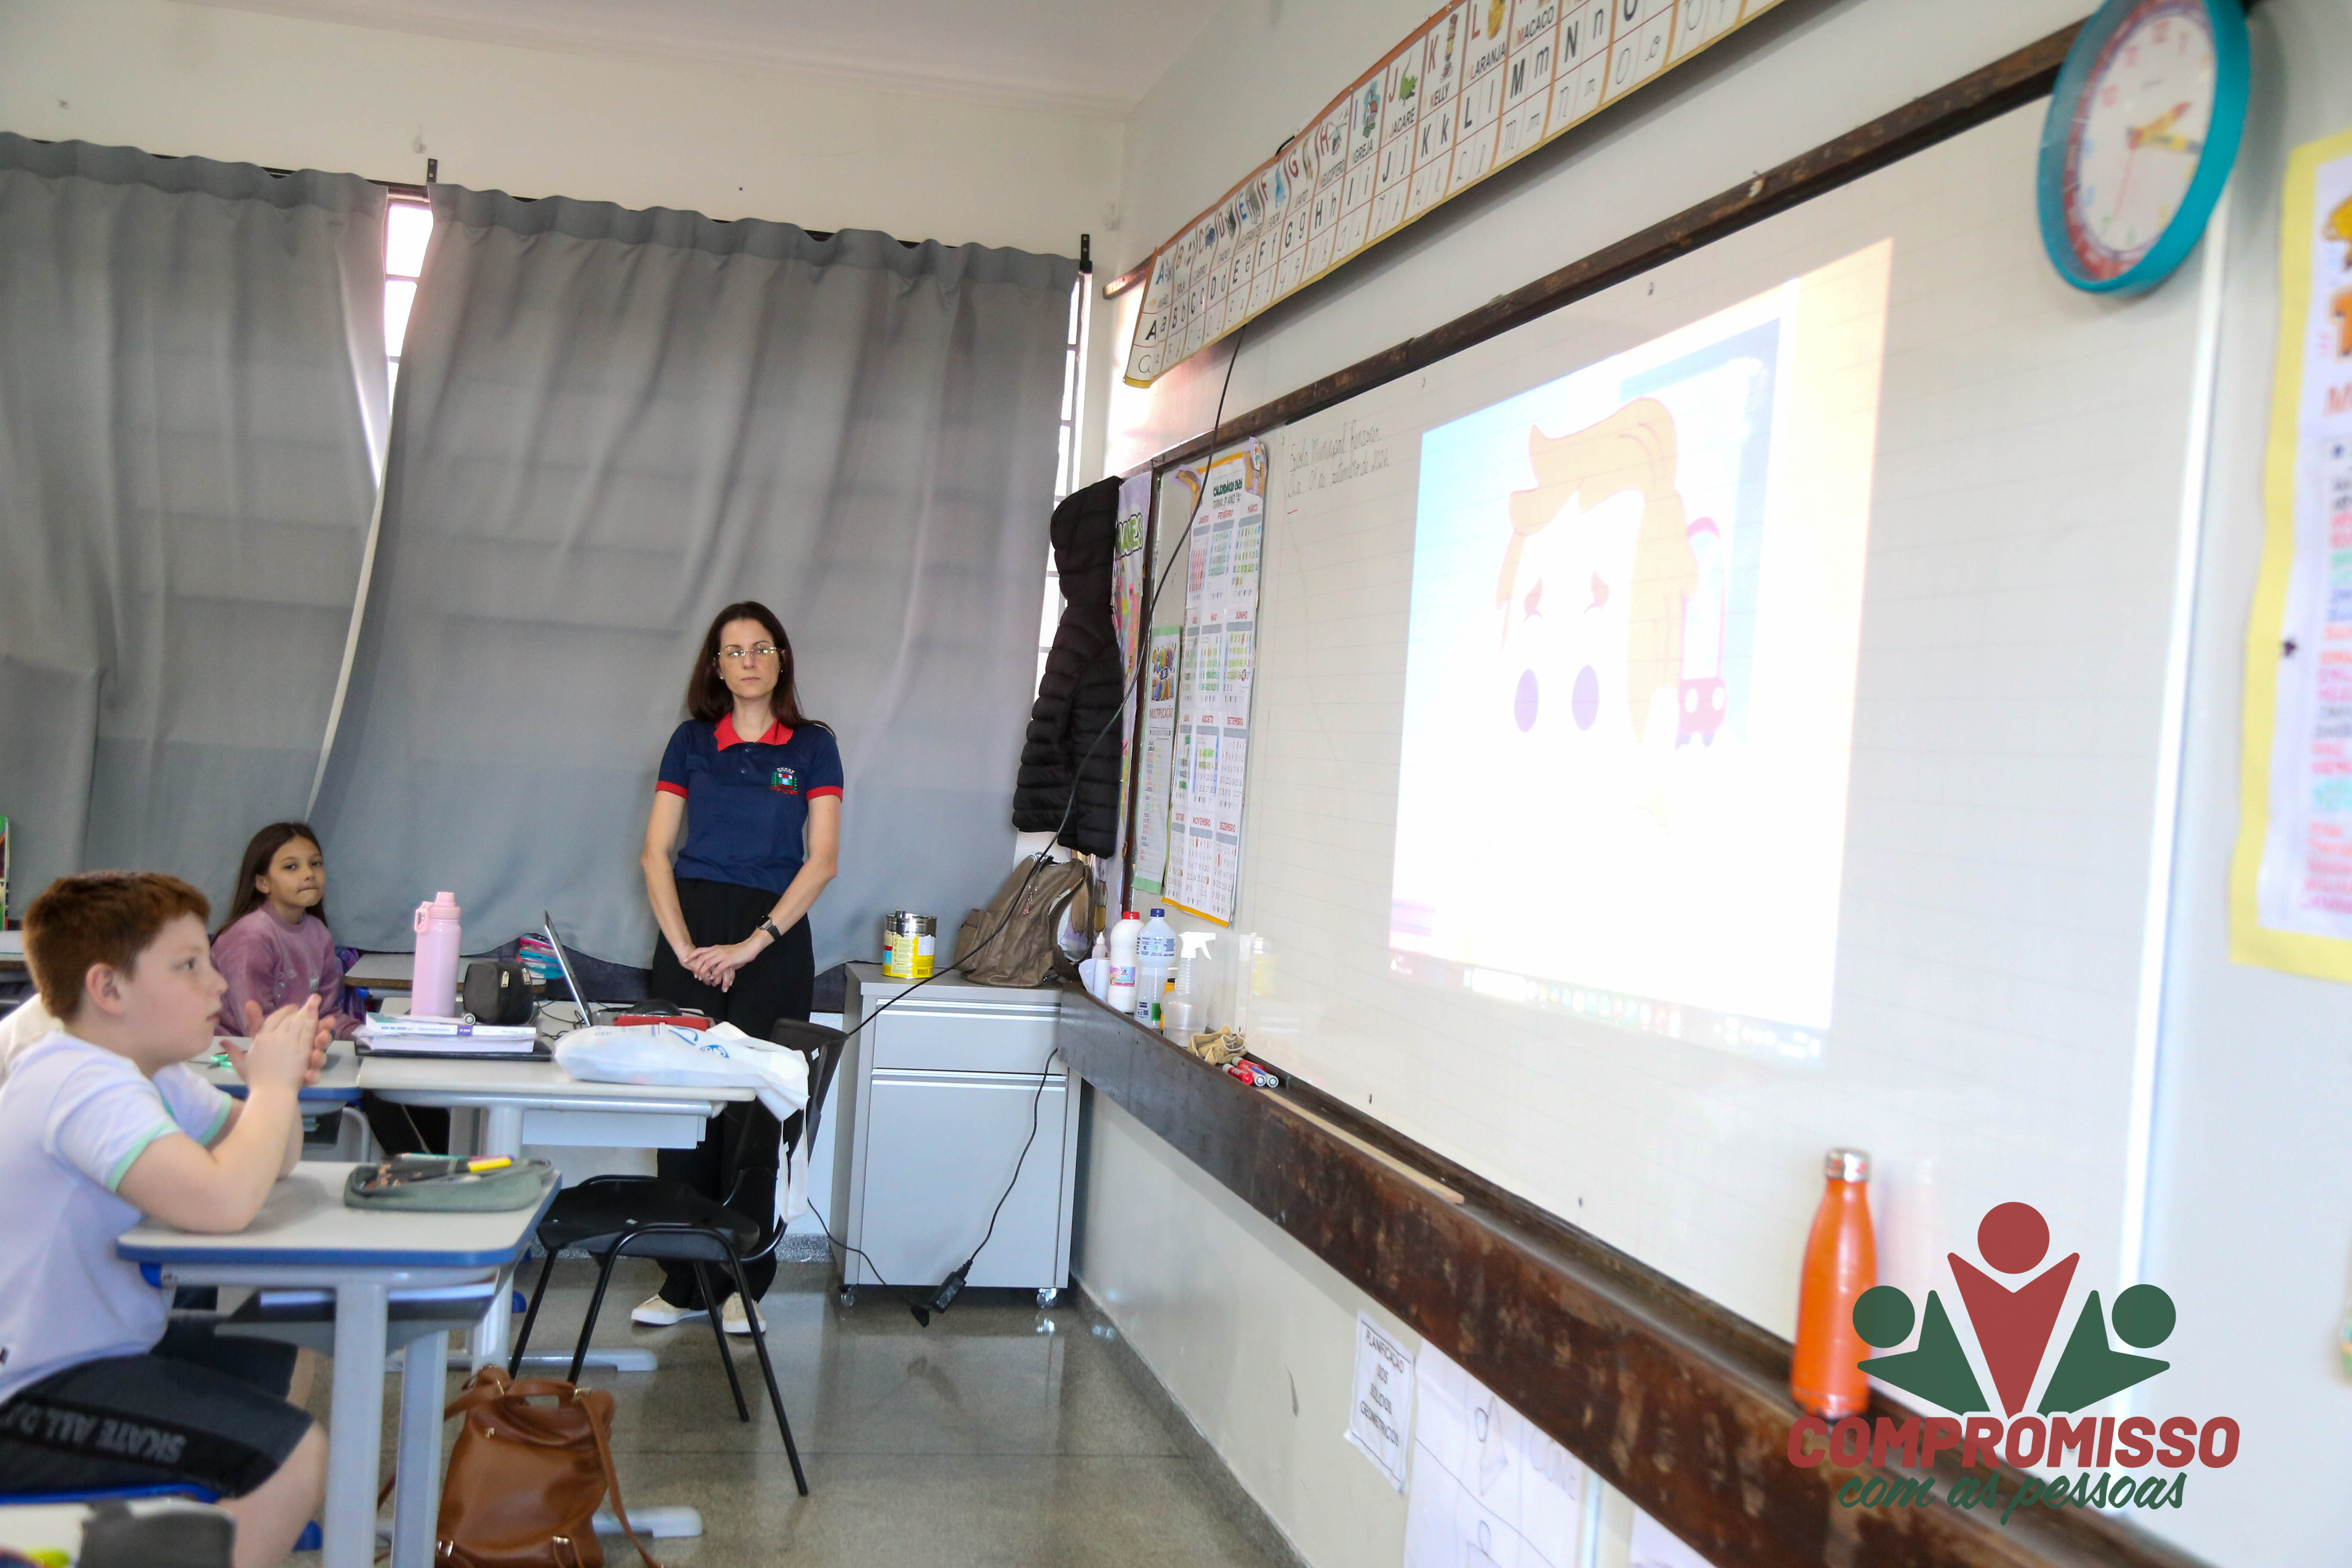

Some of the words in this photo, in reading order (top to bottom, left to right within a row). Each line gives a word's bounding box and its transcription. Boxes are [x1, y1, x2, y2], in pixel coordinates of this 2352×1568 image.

[1517, 5, 1554, 46] MACACO
[1565, 20, 1578, 63] N
[1593, 9, 1604, 40] n
[1428, 34, 1439, 74] K
[1470, 41, 1505, 80] LARANJA
[1510, 58, 1525, 99] M
[1534, 46, 1549, 79] m
[1430, 81, 1451, 109] KELLY
[1464, 96, 1472, 129] L
[1421, 123, 1431, 158] K
[1382, 151, 1391, 183] J
[1400, 135, 1409, 175] j
[1364, 166, 1370, 196] i
[1314, 199, 1323, 230] H
[1329, 192, 1337, 219] h
[1285, 221, 1293, 249] G
[1299, 211, 1306, 240] g
[1259, 240, 1266, 267] F
[1155, 261, 1164, 285] A
[1210, 276, 1216, 300] D
[1222, 268, 1227, 293] d
[1233, 259, 1240, 285] E
[1245, 254, 1250, 273] e
[1145, 320, 1157, 341] A
[1161, 316, 1167, 333] a
[1172, 306, 1178, 329] B
[1181, 301, 1185, 322] b
[1202, 715, 1214, 723] AGOSTO
[1227, 716, 1244, 726] SETEMBRO
[1193, 816, 1211, 827] NOVEMBRO
[1219, 821, 1236, 833] DEZEMBRO
[1377, 1363, 1389, 1384] DOS
